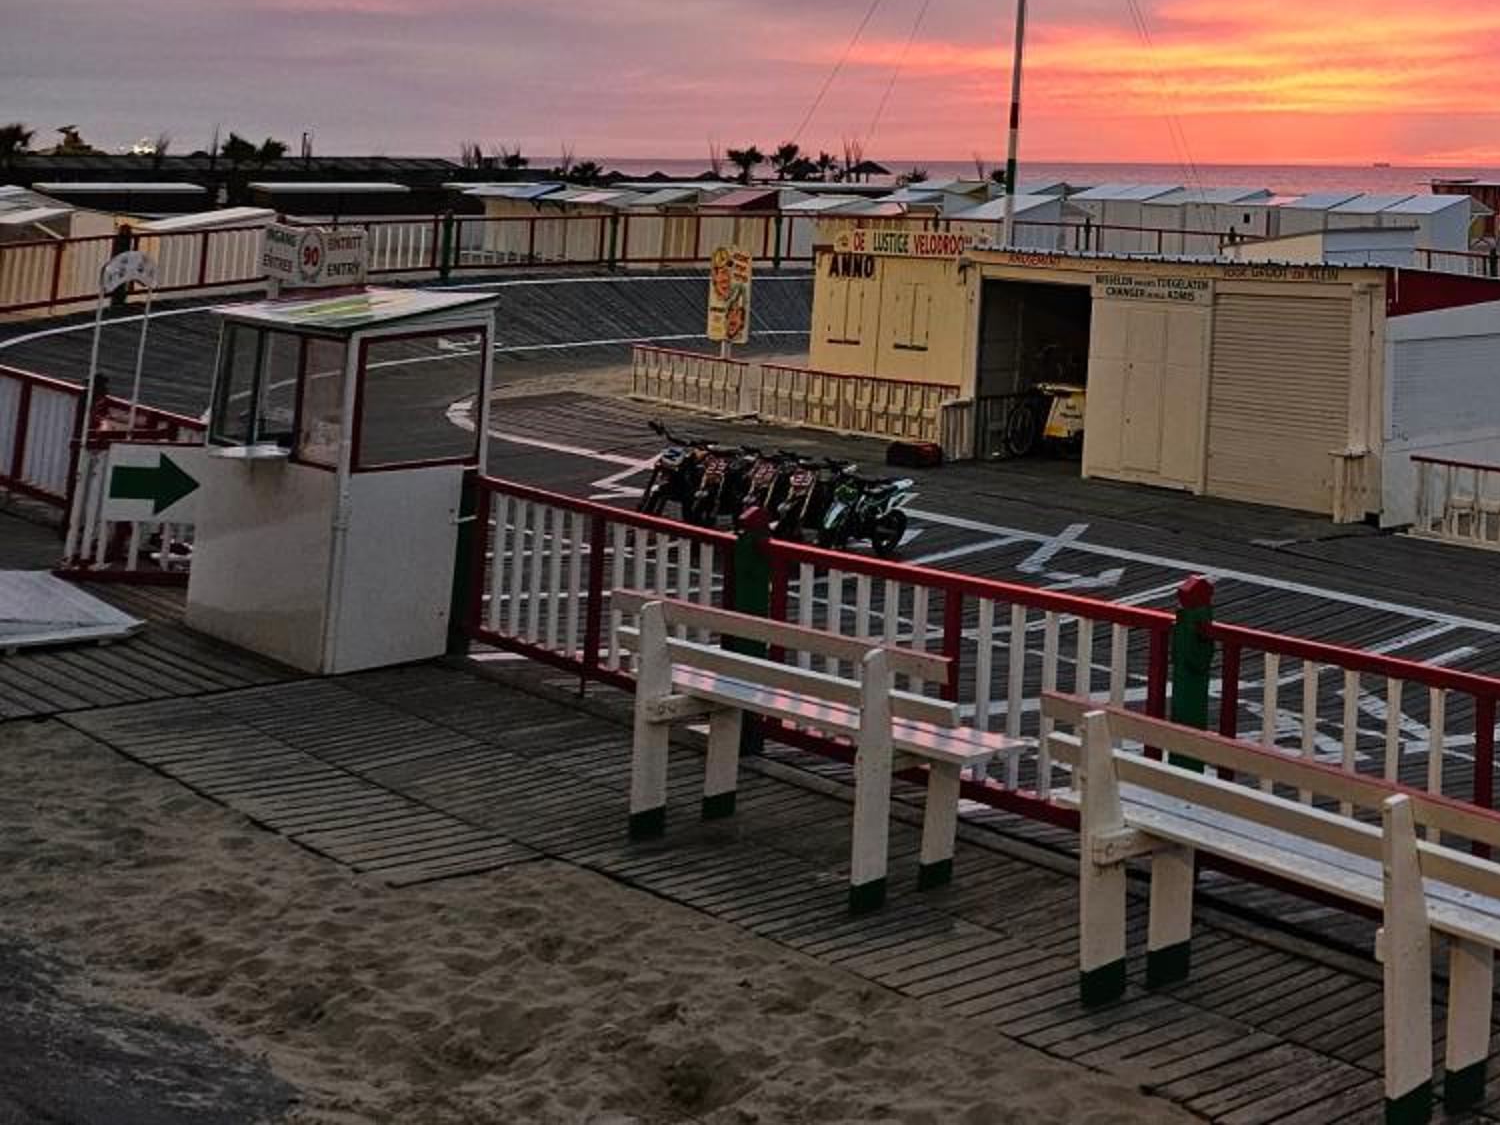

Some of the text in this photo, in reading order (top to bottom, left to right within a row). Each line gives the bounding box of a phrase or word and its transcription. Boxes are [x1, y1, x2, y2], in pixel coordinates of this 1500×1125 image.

[853, 232, 865, 252] DE
[303, 246, 320, 267] 90
[828, 253, 875, 278] ANNO
[327, 262, 360, 277] ENTRY
